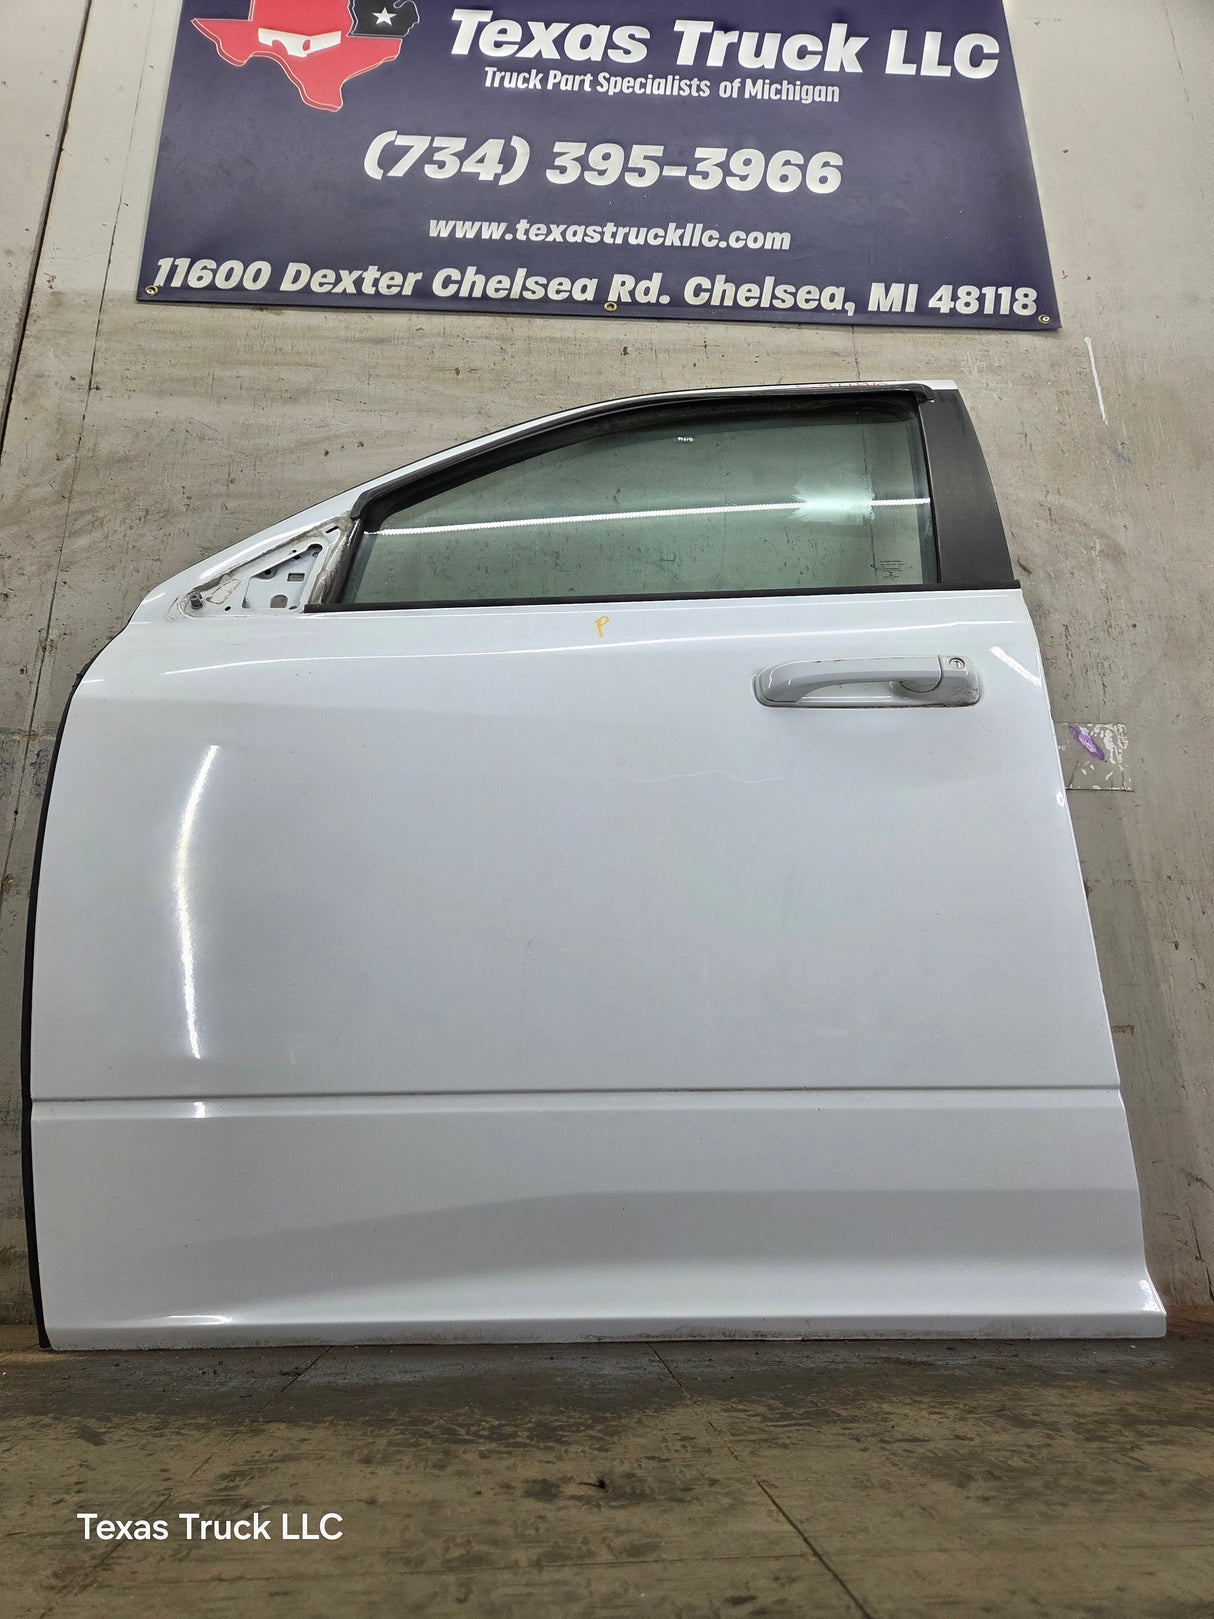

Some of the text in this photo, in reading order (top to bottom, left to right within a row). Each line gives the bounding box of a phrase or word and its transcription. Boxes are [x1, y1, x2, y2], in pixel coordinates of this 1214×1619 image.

[451, 9, 999, 79] Texas Truck LLC
[485, 67, 839, 104] Truck Part Specialists of Michigan
[364, 130, 843, 194] (734) 395-3966
[429, 219, 791, 250] www.texastruckllc.com
[153, 258, 1037, 316] 11600 Dexter Chelsea Rd. Chelsea, MI 48118
